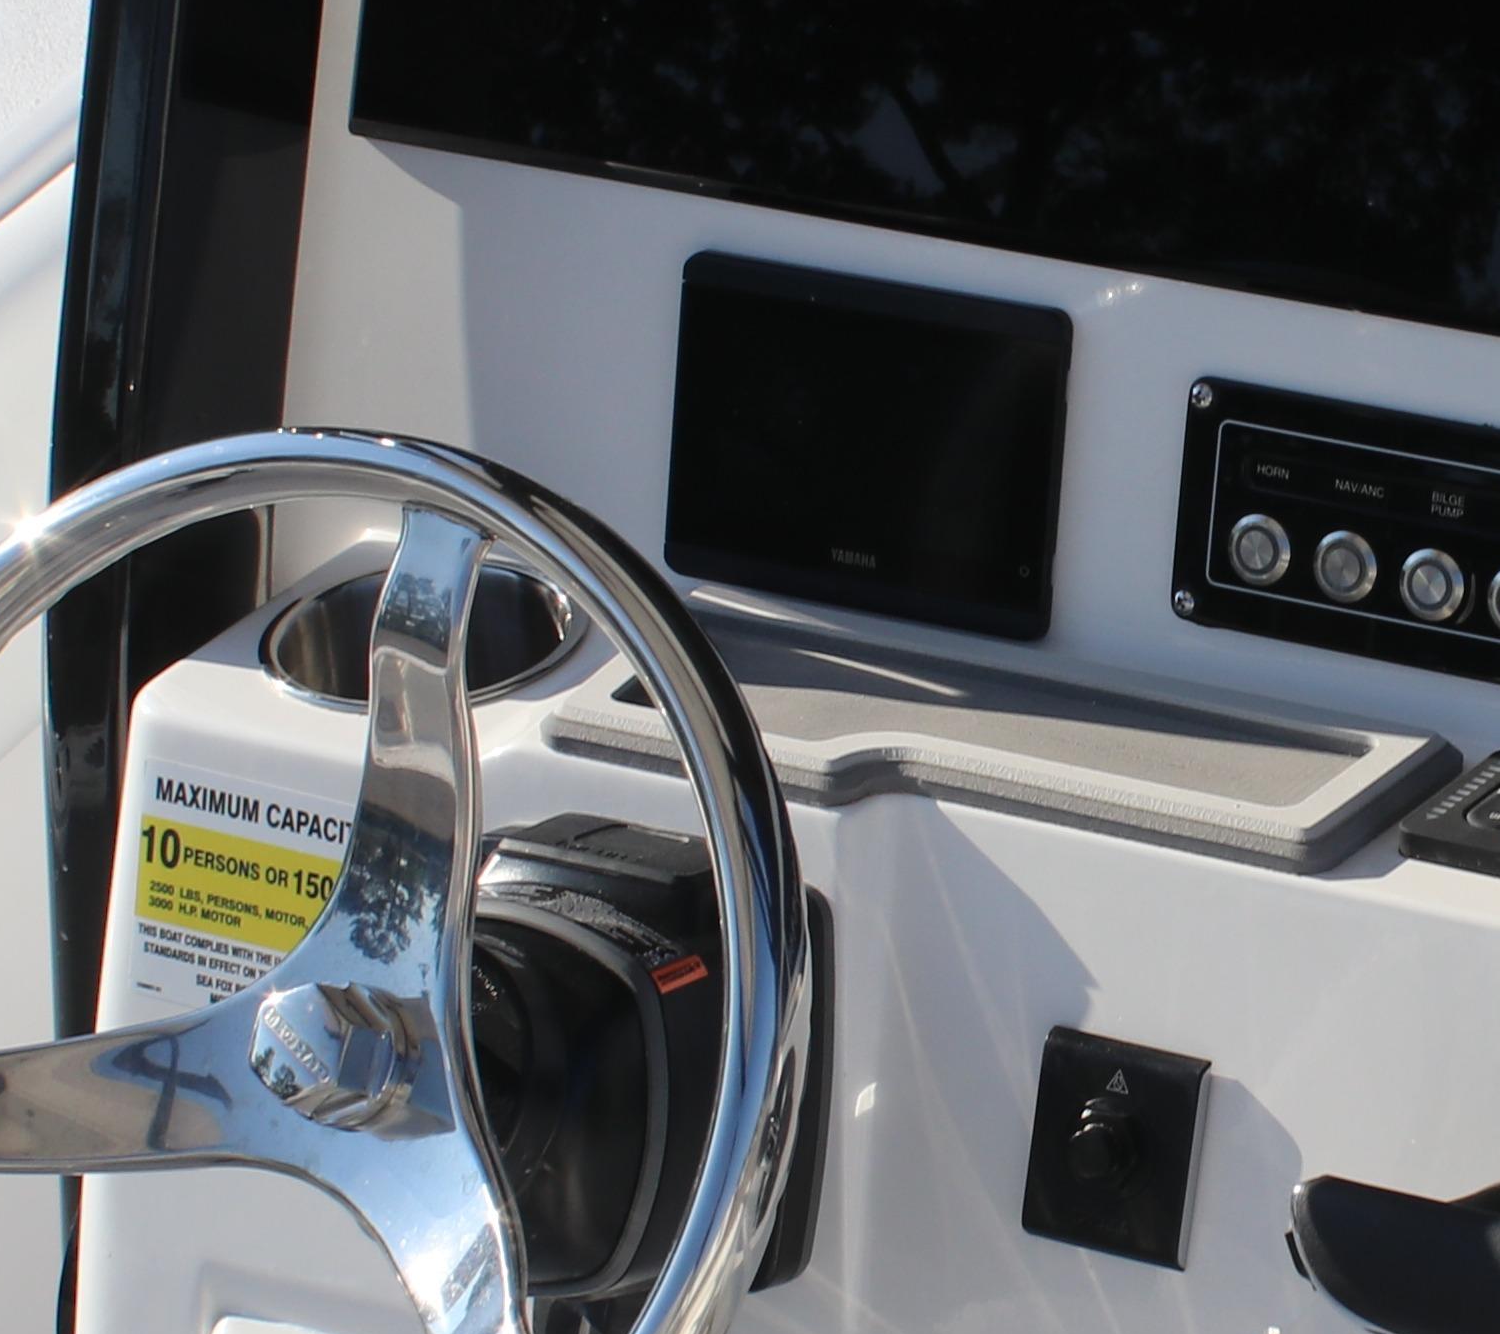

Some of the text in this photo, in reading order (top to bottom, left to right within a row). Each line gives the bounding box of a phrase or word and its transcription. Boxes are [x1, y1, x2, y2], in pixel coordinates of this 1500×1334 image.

[1256, 464, 1290, 480] HORN
[1430, 503, 1464, 518] PUMP
[1431, 490, 1464, 508] BILGE
[831, 547, 876, 569] YAMAHA
[155, 776, 260, 824] MAXIMUM
[141, 824, 181, 870] 10
[183, 846, 261, 881] PERSONS
[265, 866, 289, 888] OR
[148, 895, 174, 911] 3000
[200, 907, 242, 928] MOTOR
[149, 880, 175, 896] 2500
[206, 893, 262, 919] PERSONS,
[138, 922, 158, 938] THIS
[159, 928, 183, 943] BOAT
[184, 934, 229, 956] COMPLIES
[231, 946, 253, 960] WITH
[255, 951, 272, 966] THE
[144, 941, 195, 965] STANDARDS
[197, 955, 207, 967] IN
[208, 957, 241, 975] EFFECT
[242, 965, 257, 979] ON
[196, 973, 213, 988] SEA
[215, 978, 233, 993] FOX
